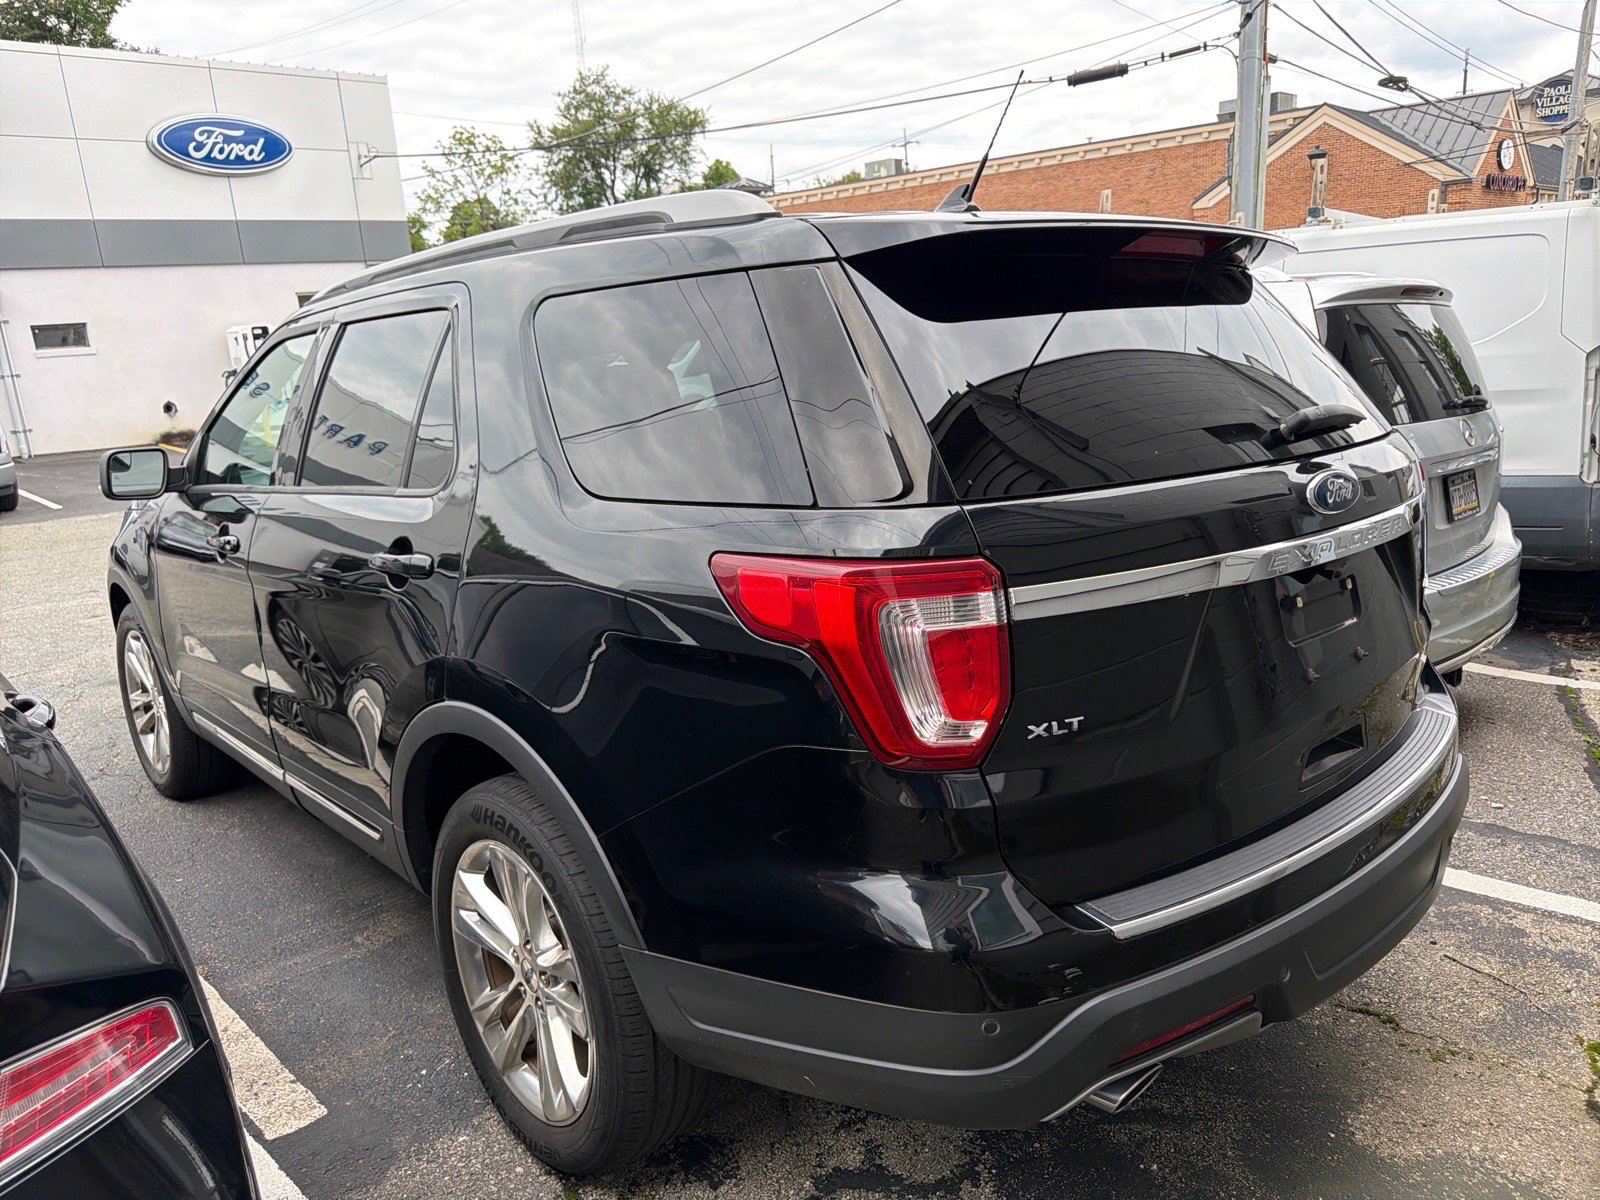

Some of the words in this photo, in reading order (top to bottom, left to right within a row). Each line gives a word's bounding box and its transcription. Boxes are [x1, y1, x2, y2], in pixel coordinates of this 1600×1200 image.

[1536, 95, 1571, 107] VILLAG
[1544, 84, 1572, 97] PAOLI
[1536, 104, 1570, 118] SHOPPE
[188, 126, 266, 162] Ford
[1489, 173, 1517, 192] CONCORD
[1326, 478, 1354, 504] Ford
[1267, 520, 1403, 572] EXPLORER
[1027, 716, 1085, 740] XLT
